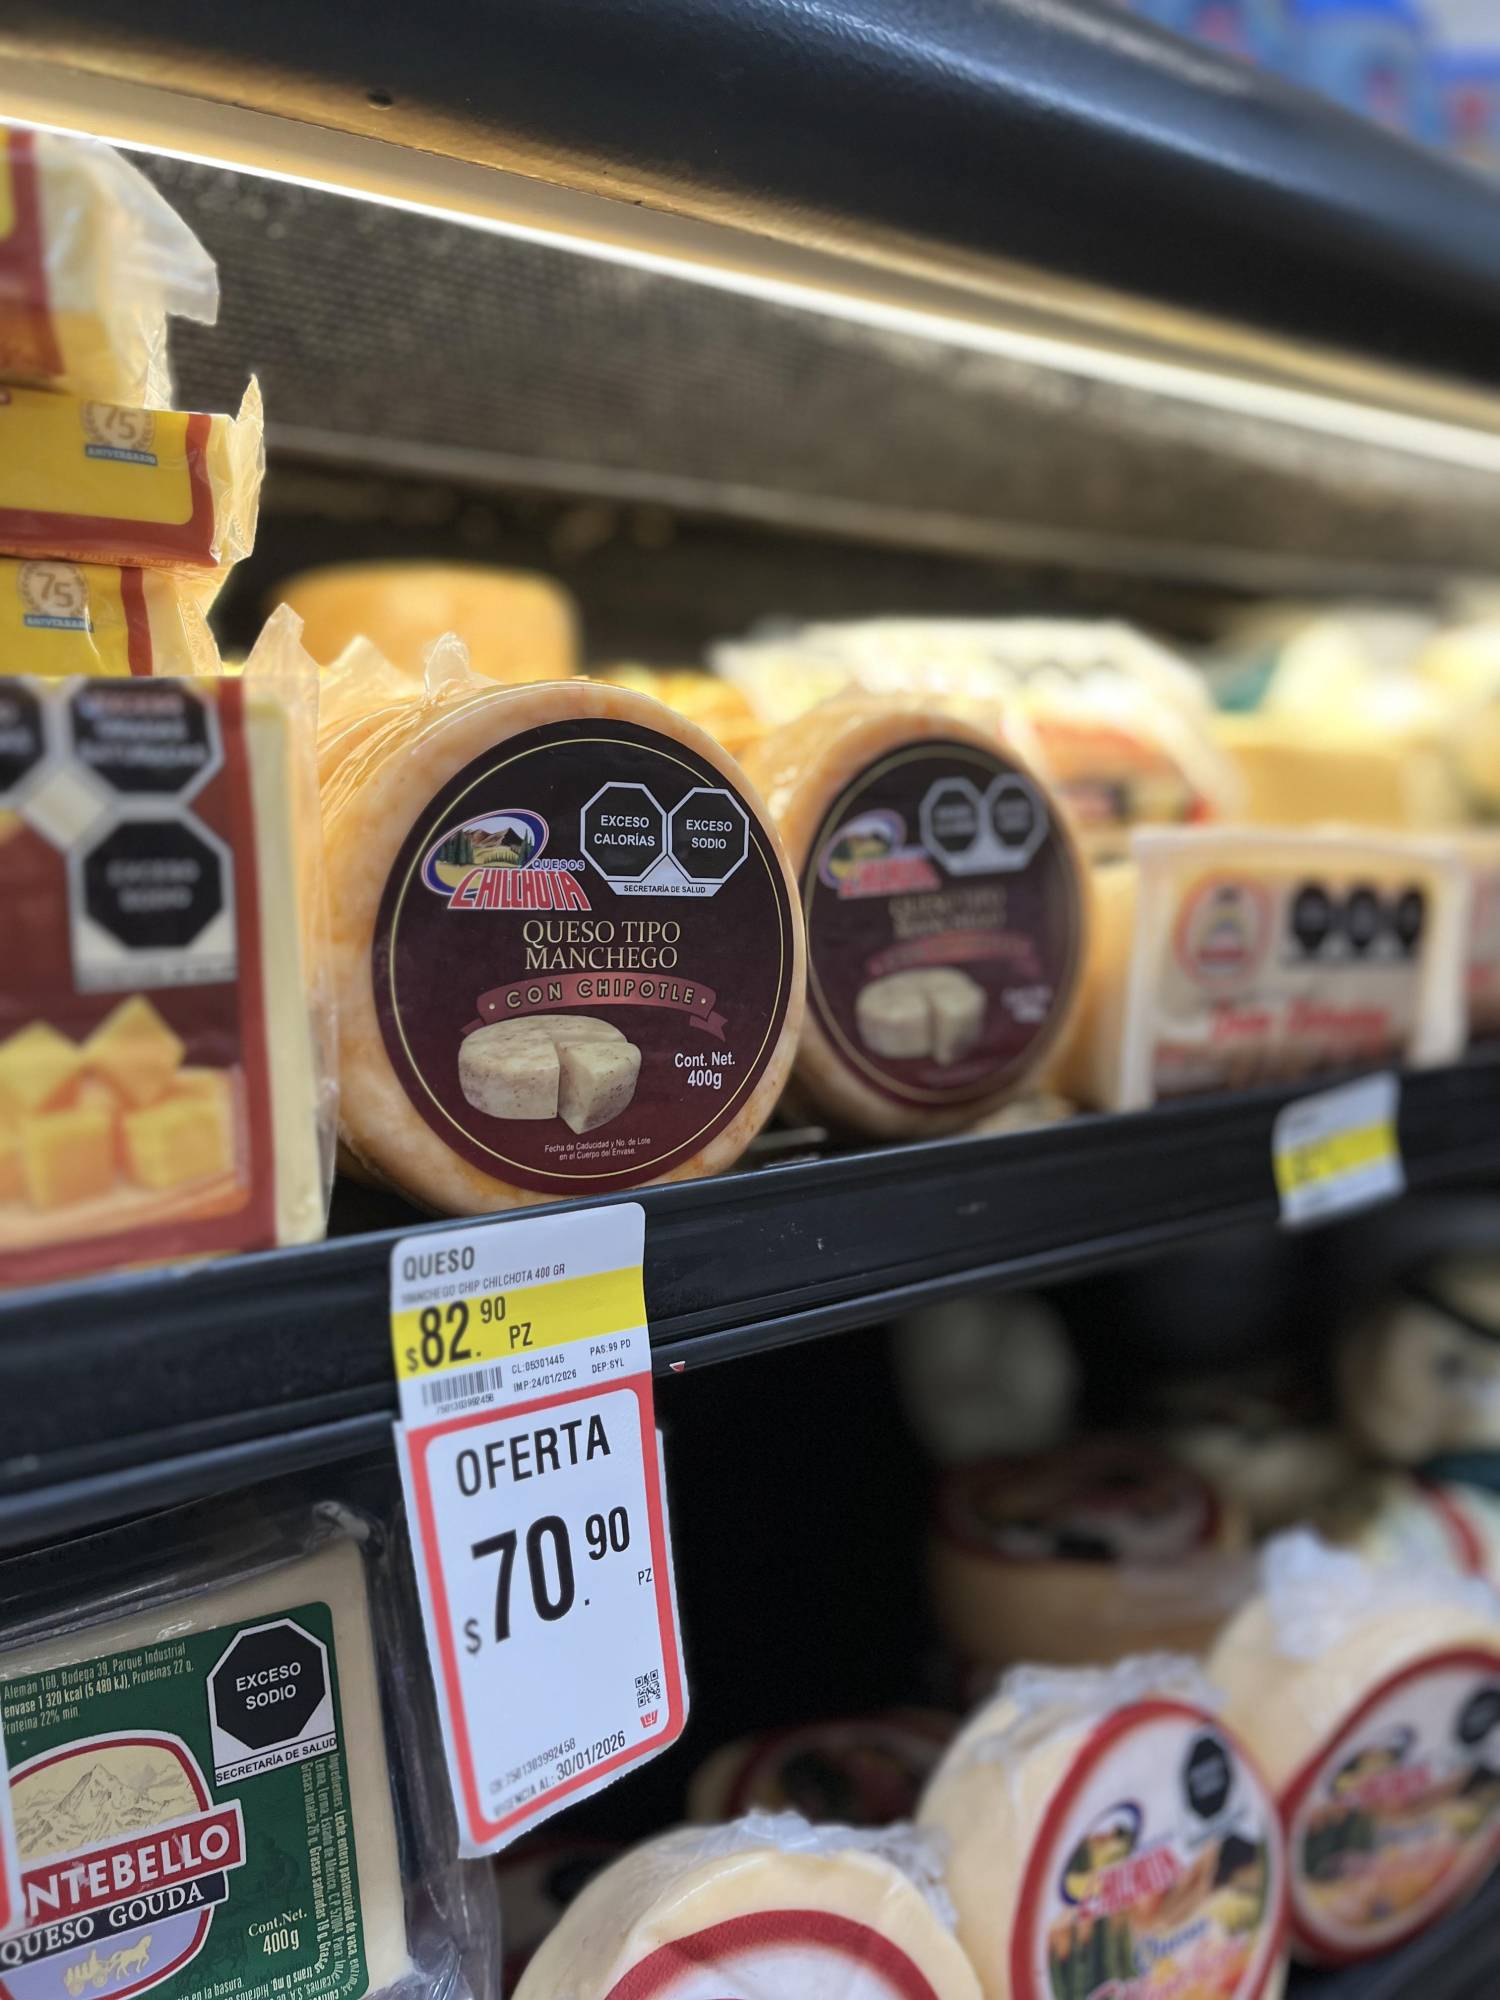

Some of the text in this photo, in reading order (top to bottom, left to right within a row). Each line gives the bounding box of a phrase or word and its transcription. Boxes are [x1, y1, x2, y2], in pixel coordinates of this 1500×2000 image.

[36, 572, 74, 608] 75
[600, 815, 650, 829] EXCESO
[686, 819, 733, 833] EXCESO
[593, 832, 656, 847] CALORÍAS
[691, 837, 727, 849] SODIO
[532, 859, 586, 871] QUESOS
[447, 867, 592, 911] CHILCHOTA
[623, 884, 706, 894] SECRETARÍA DE SALUD
[522, 920, 681, 948] QUESO TIPO
[524, 946, 678, 970] MANCHEGO
[506, 979, 695, 1008] CON CHIPOTLE
[674, 1051, 736, 1068] Cont. Net.
[687, 1069, 722, 1090] 400g
[544, 1144, 565, 1153] Fecha
[575, 1140, 609, 1150] Caducidad
[628, 1138, 636, 1146] de
[637, 1137, 651, 1145] Lote
[576, 1150, 600, 1160] Cuerpo
[601, 1149, 610, 1157] del
[403, 1246, 475, 1281] QUESO
[459, 1279, 480, 1294] CHIP
[483, 1269, 533, 1289] CHILCHOTA
[535, 1265, 550, 1280] 400
[553, 1263, 565, 1276] GR
[509, 1322, 533, 1350] PZ
[513, 1357, 625, 1393] IMP:24/01/2026 DEP:SYL
[456, 1414, 611, 1497] OFERTA
[637, 1567, 652, 1586] PZ
[61, 1668, 94, 1686] Bodega
[112, 1656, 143, 1672] Parque
[144, 1642, 186, 1665] Industrial
[235, 1662, 301, 1692] EXCESO
[4, 1700, 36, 1719] envase
[38, 1695, 43, 1710] 1
[45, 1690, 62, 1708] 320
[64, 1685, 83, 1703] kcal
[96, 1677, 112, 1694] 480
[245, 1684, 297, 1710] SODIO
[40, 1709, 60, 1727] 22%
[216, 1737, 337, 1783] SECRETARÍA DE SALUD
[556, 1730, 626, 1781] 30/01/2026
[334, 1809, 348, 1838] Leche
[310, 1845, 322, 1877] Grasas
[337, 1837, 349, 1866] entera
[26, 1824, 230, 1918] NTEBELLO
[312, 1876, 327, 1920] saturadas
[339, 1866, 356, 1921] pasteurizada
[0, 1881, 205, 1965] QUESO GOUDA
[316, 1919, 330, 1932] 19
[345, 1921, 358, 1934] de
[314, 1941, 331, 1974] Grasas
[286, 1974, 292, 1988] 0
[292, 1966, 313, 1983] trans
[204, 1986, 213, 1999] la
